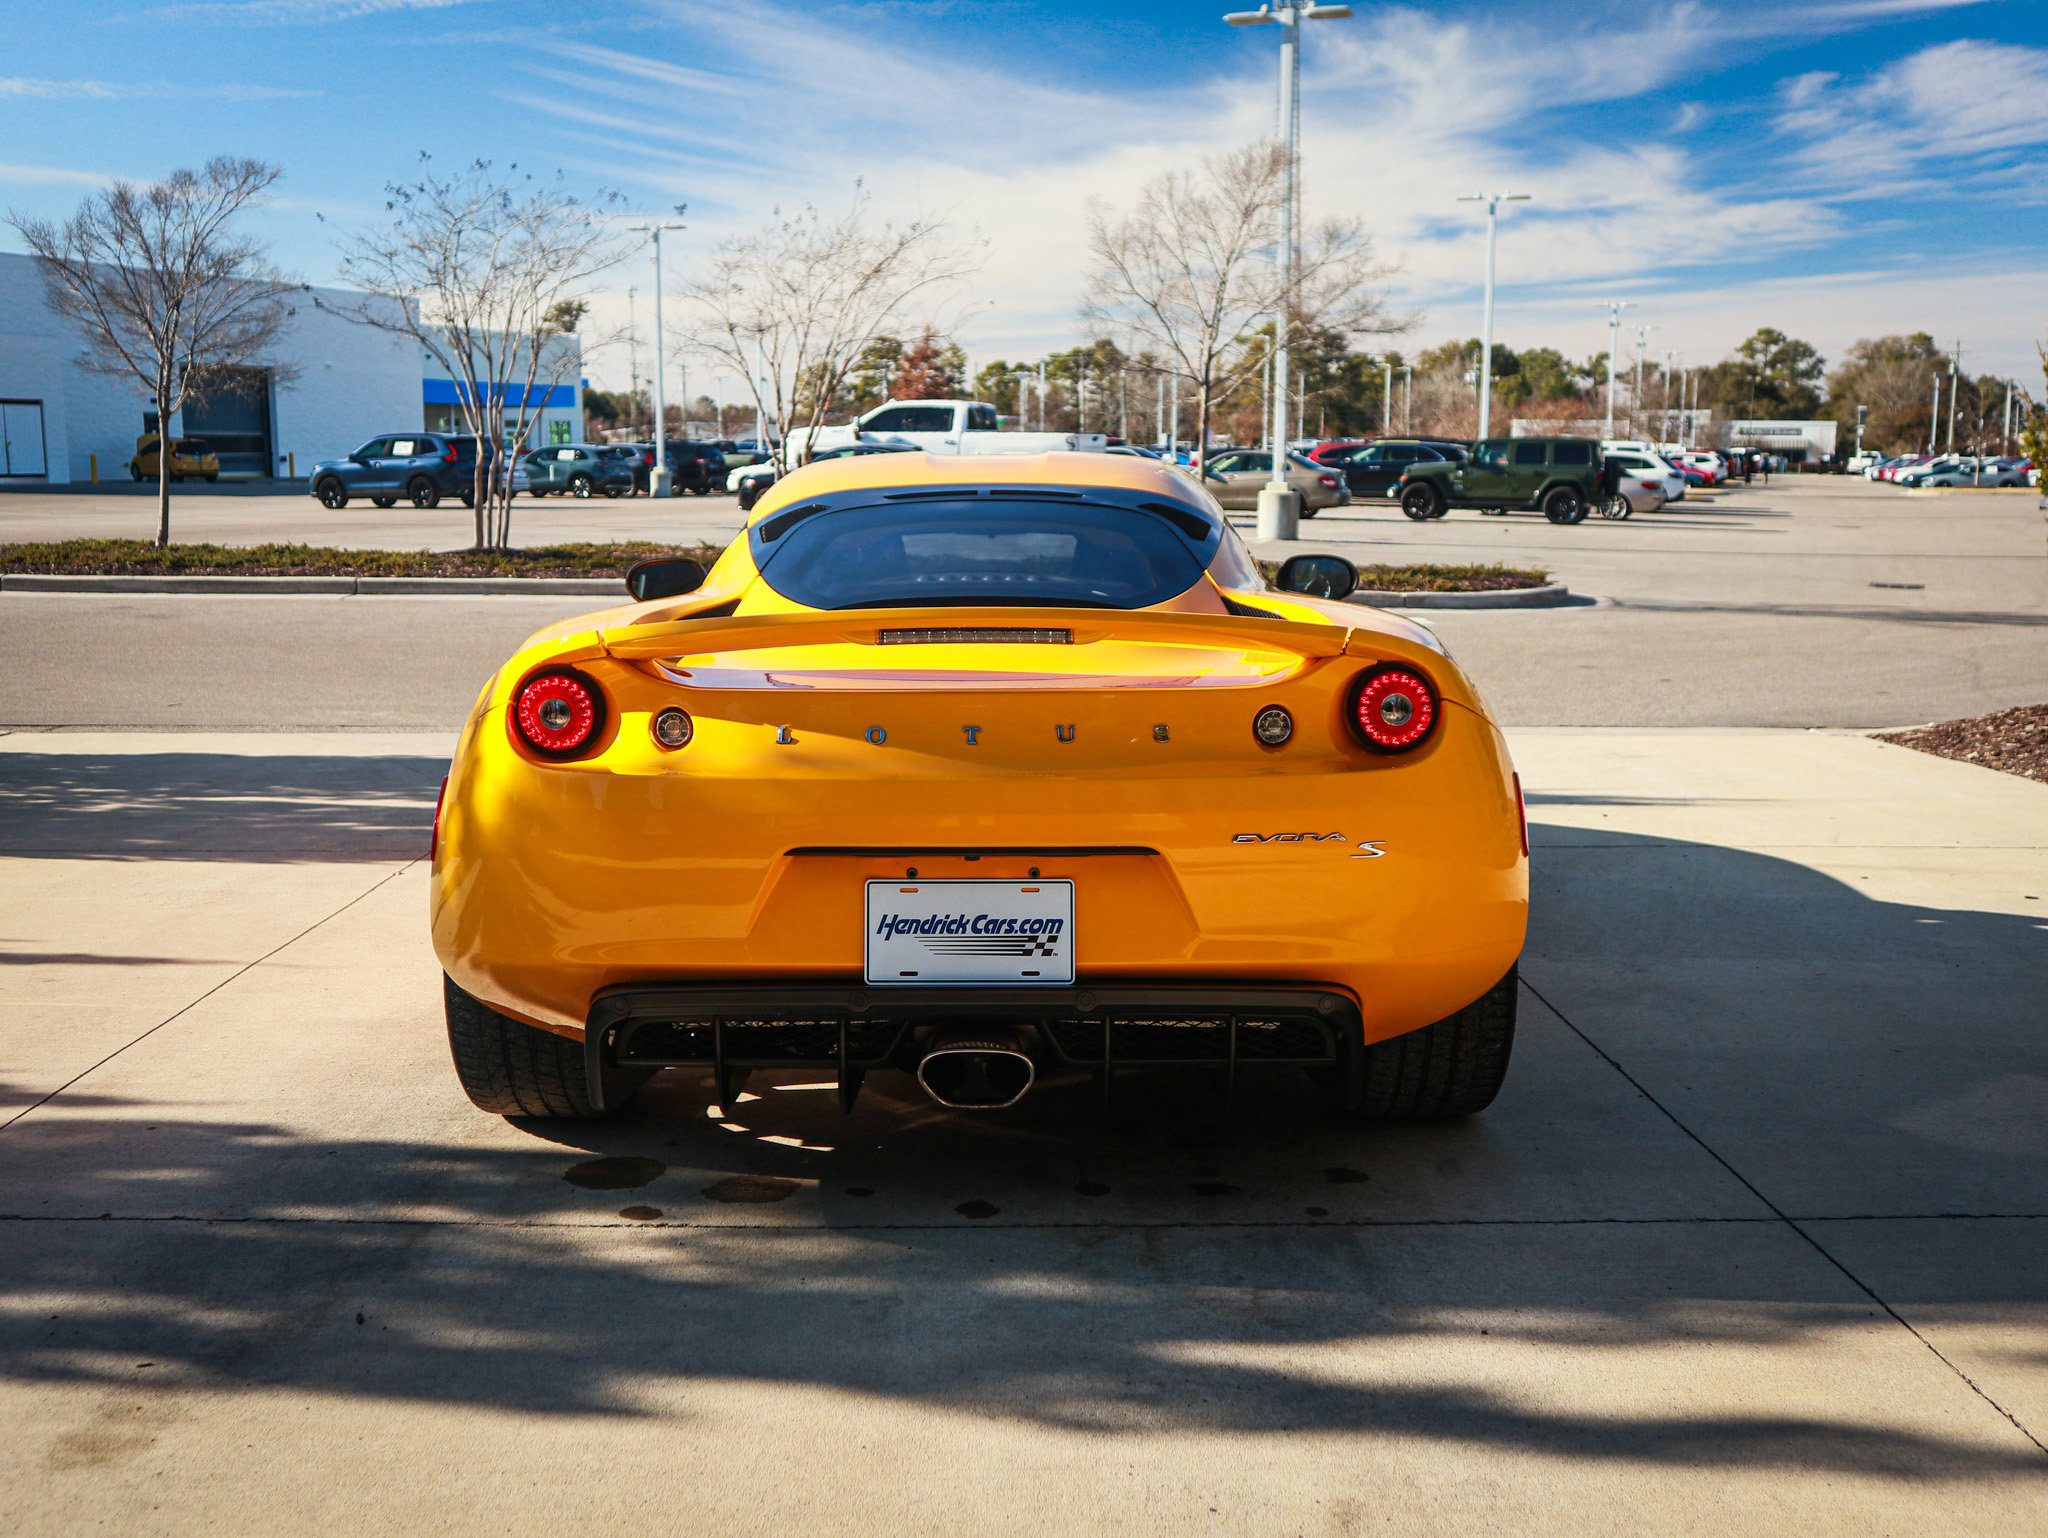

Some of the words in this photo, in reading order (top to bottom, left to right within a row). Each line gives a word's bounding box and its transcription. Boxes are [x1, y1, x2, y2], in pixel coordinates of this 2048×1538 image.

[775, 725, 1172, 745] LOTUS
[1232, 832, 1347, 844] EVORA
[1349, 841, 1387, 859] S
